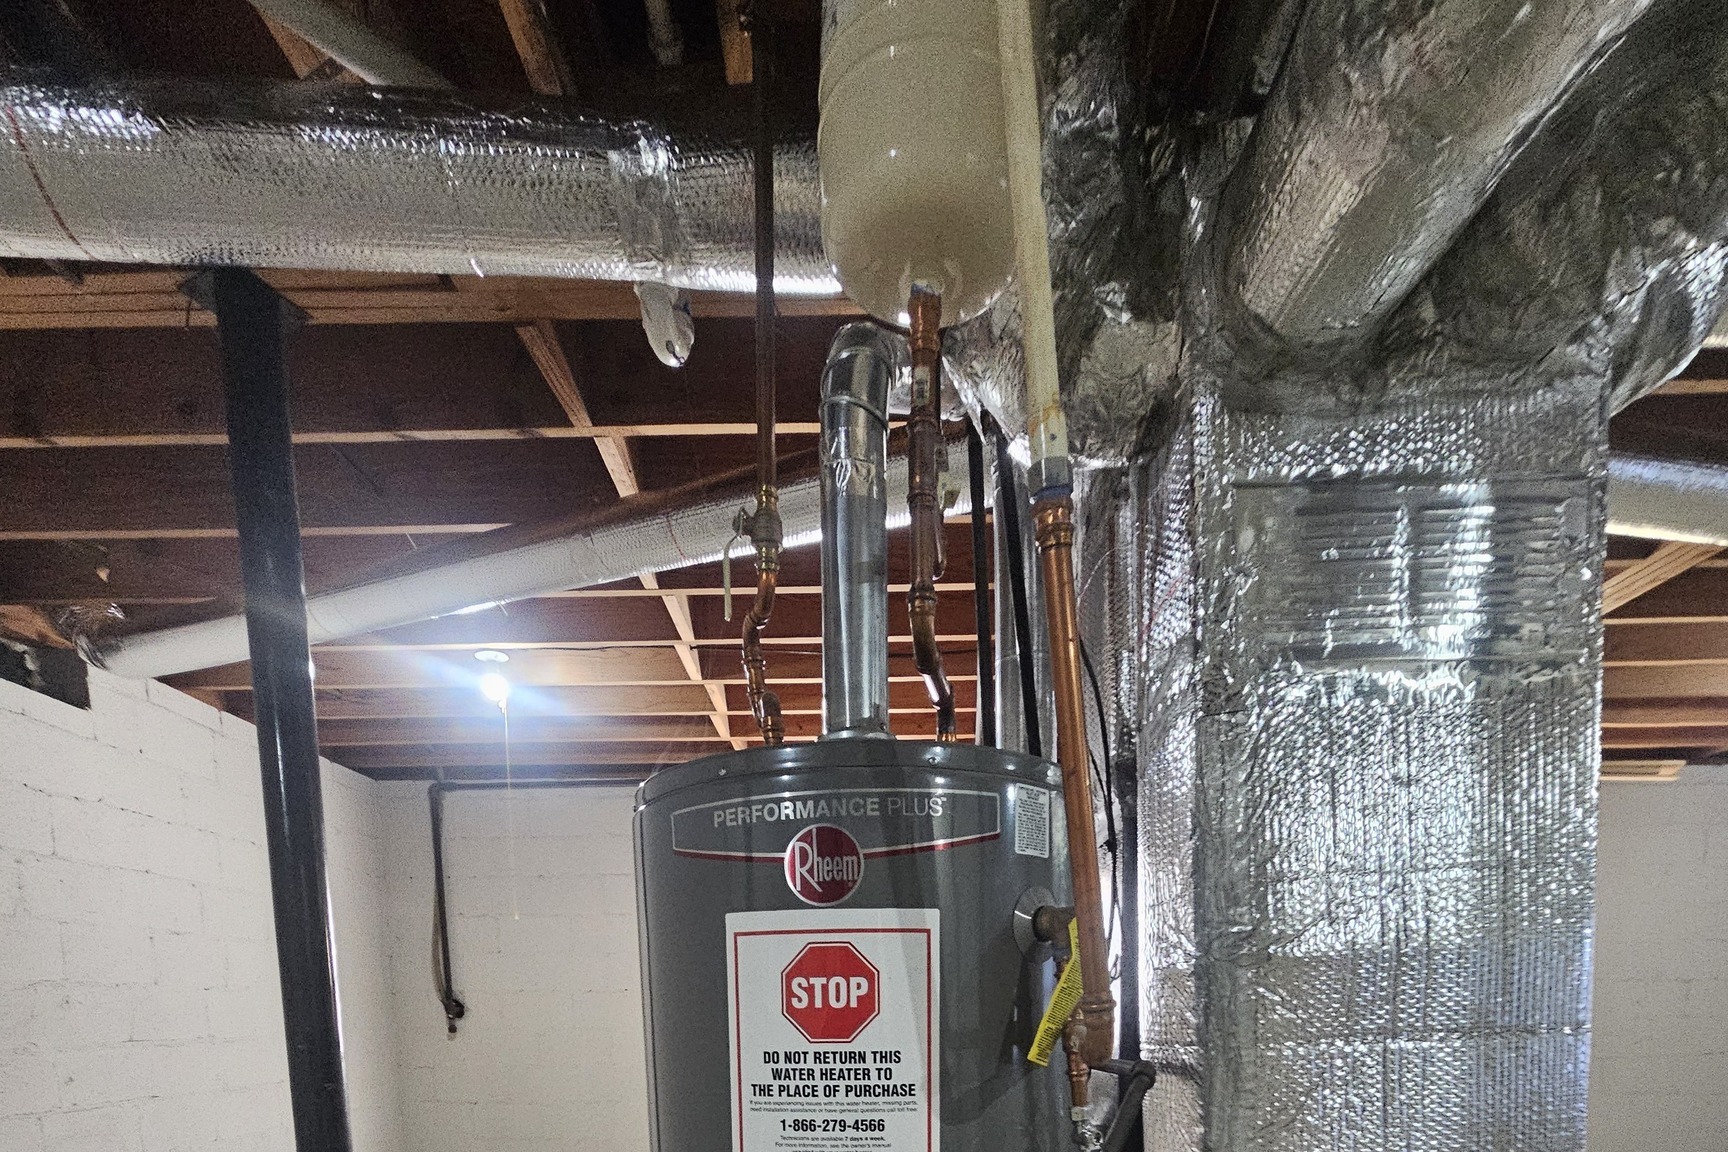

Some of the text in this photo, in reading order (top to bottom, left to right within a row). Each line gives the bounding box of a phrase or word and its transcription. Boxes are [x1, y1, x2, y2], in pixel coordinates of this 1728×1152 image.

[714, 797, 944, 828] PERFORMANCE PLUS
[794, 828, 859, 892] Rheem
[791, 976, 869, 1009] STOP
[763, 1050, 902, 1065] DO NOT RETURN THIS
[771, 1067, 893, 1081] WATER HEATER TO
[751, 1083, 916, 1098] THE PLACE OF PURCHASE
[779, 1119, 885, 1132] 1-866-279-4566
